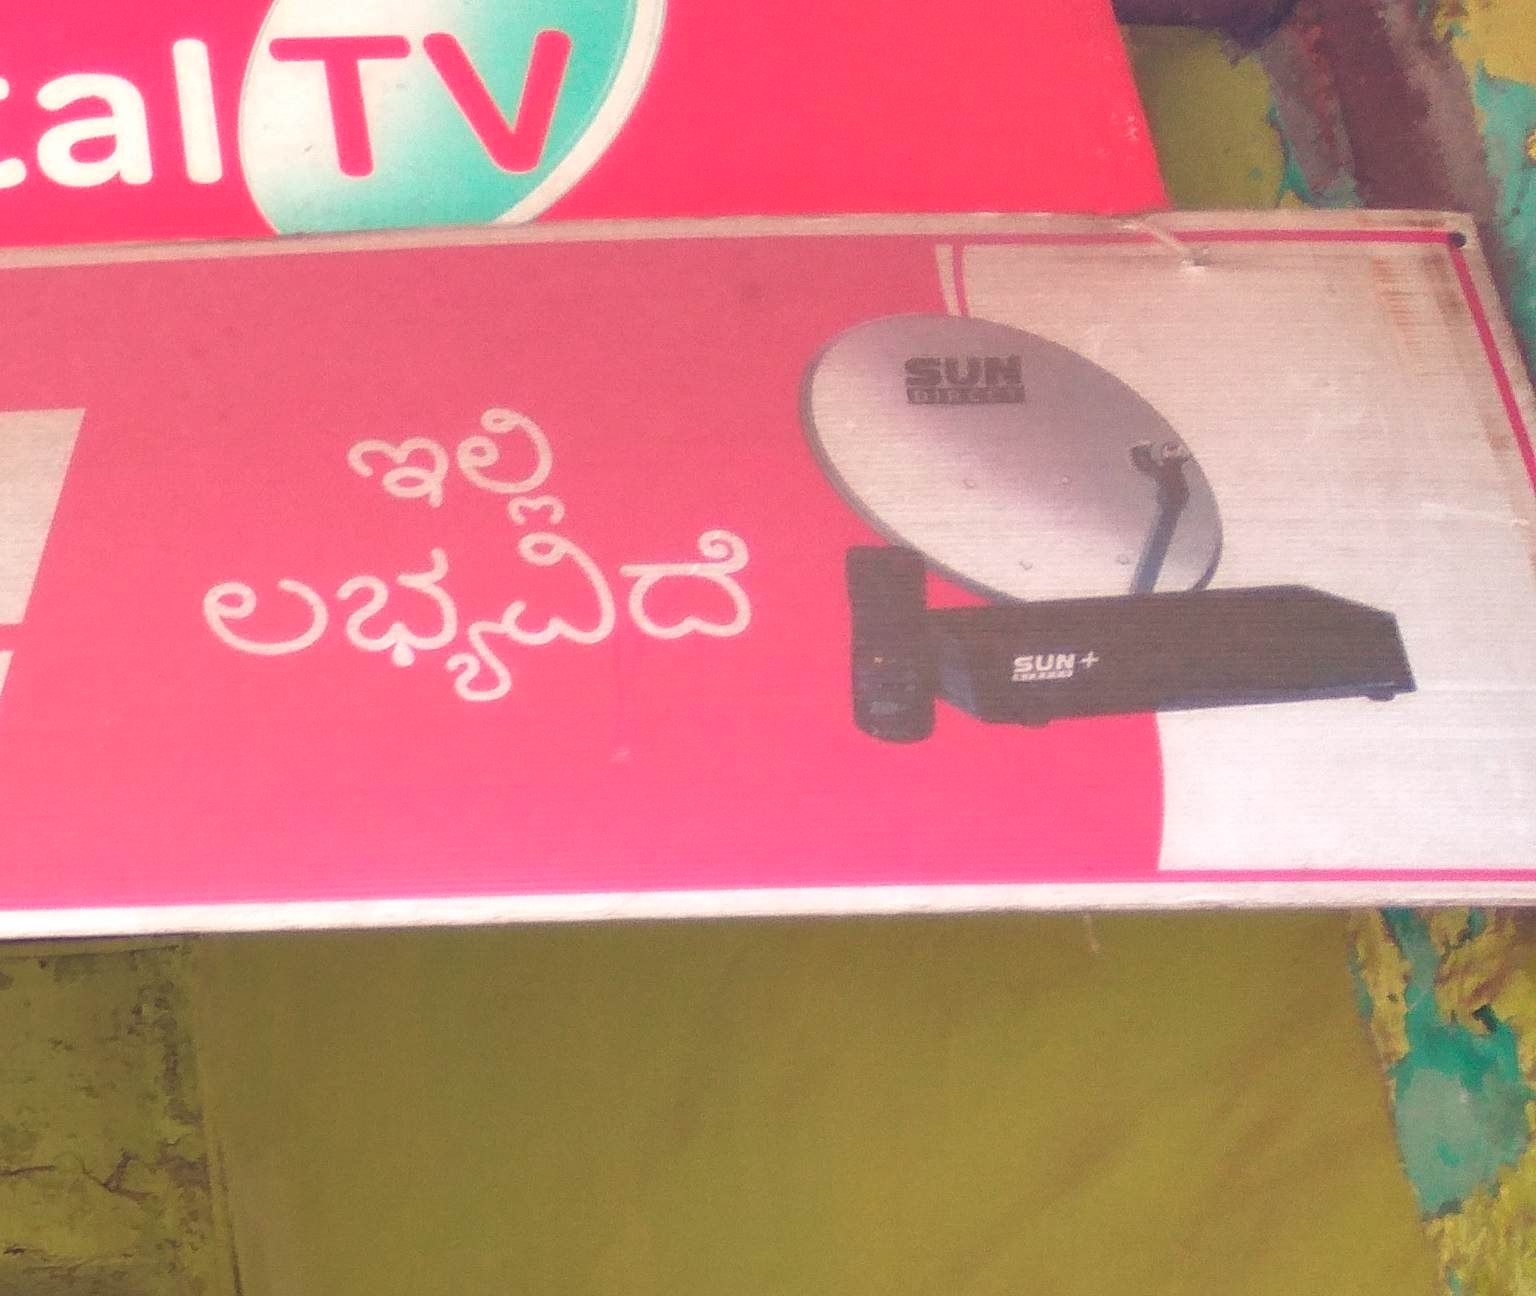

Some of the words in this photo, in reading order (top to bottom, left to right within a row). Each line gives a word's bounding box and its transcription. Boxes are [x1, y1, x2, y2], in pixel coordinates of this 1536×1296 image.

[268, 28, 573, 179] TV
[904, 354, 1023, 387] SUN
[347, 406, 565, 527] ಇಲ್ಲಿ
[202, 527, 753, 702] ಲಭ್ಯವಿದೆ
